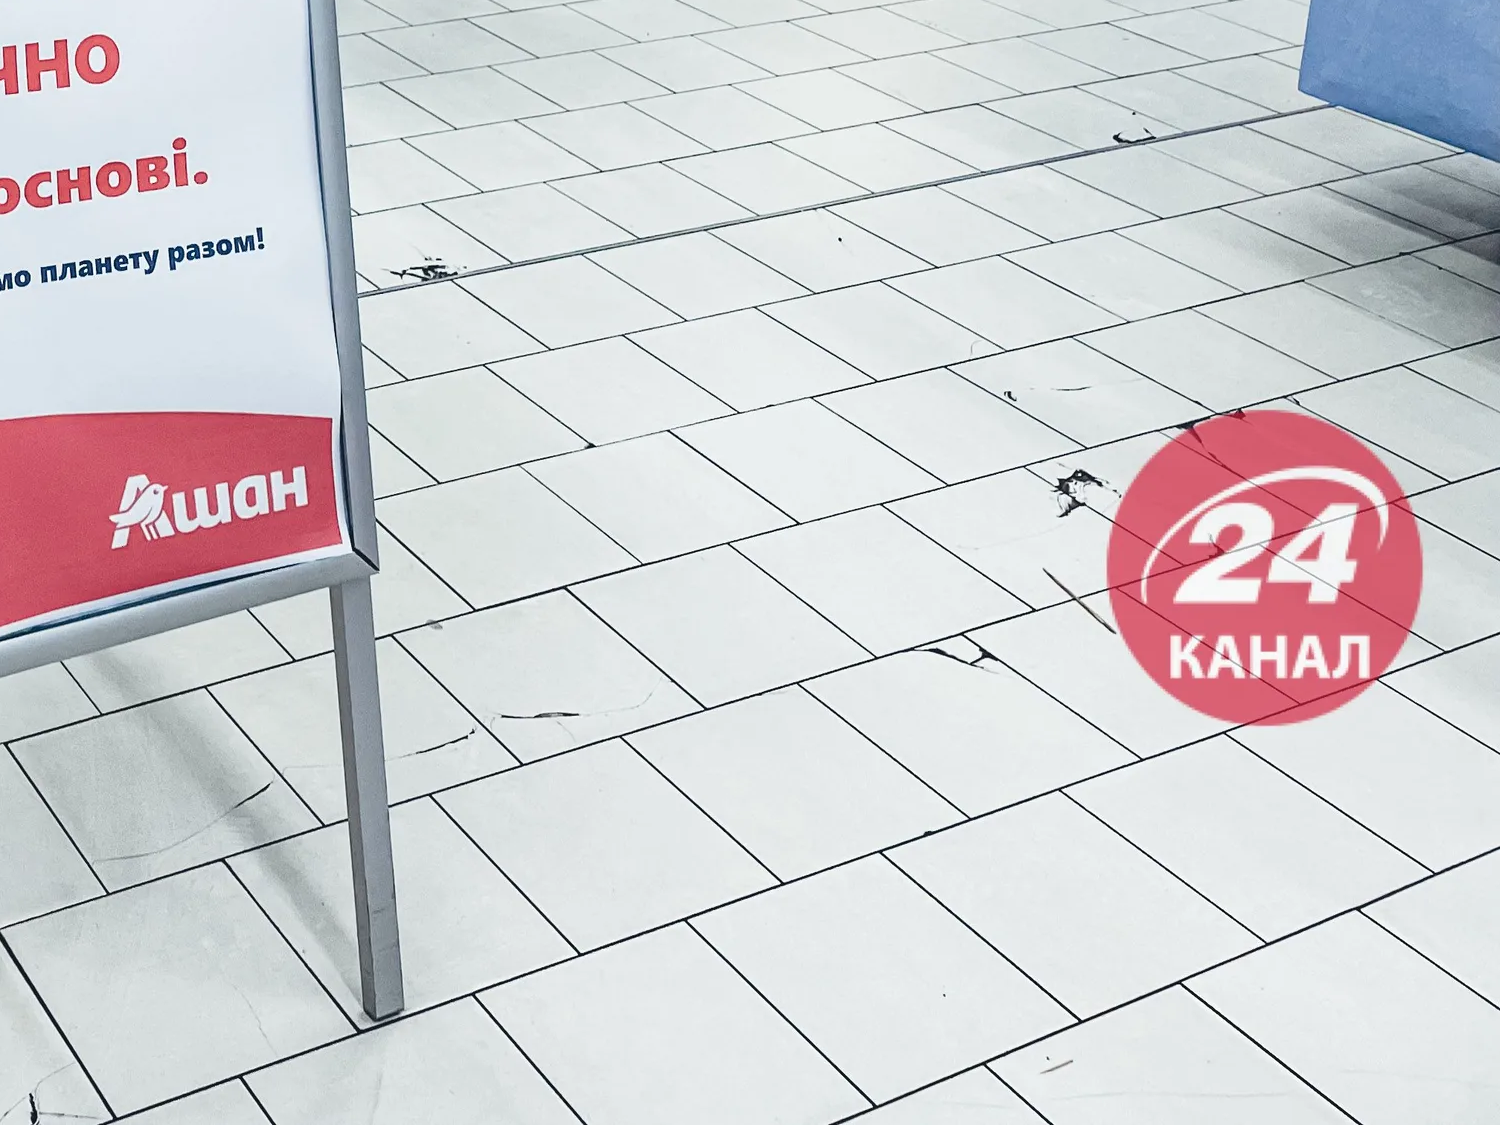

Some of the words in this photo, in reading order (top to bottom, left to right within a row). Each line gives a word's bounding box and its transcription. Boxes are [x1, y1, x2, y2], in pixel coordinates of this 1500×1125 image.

[40, 249, 159, 284] планету
[167, 227, 265, 271] разом!
[109, 465, 309, 549] Ашан
